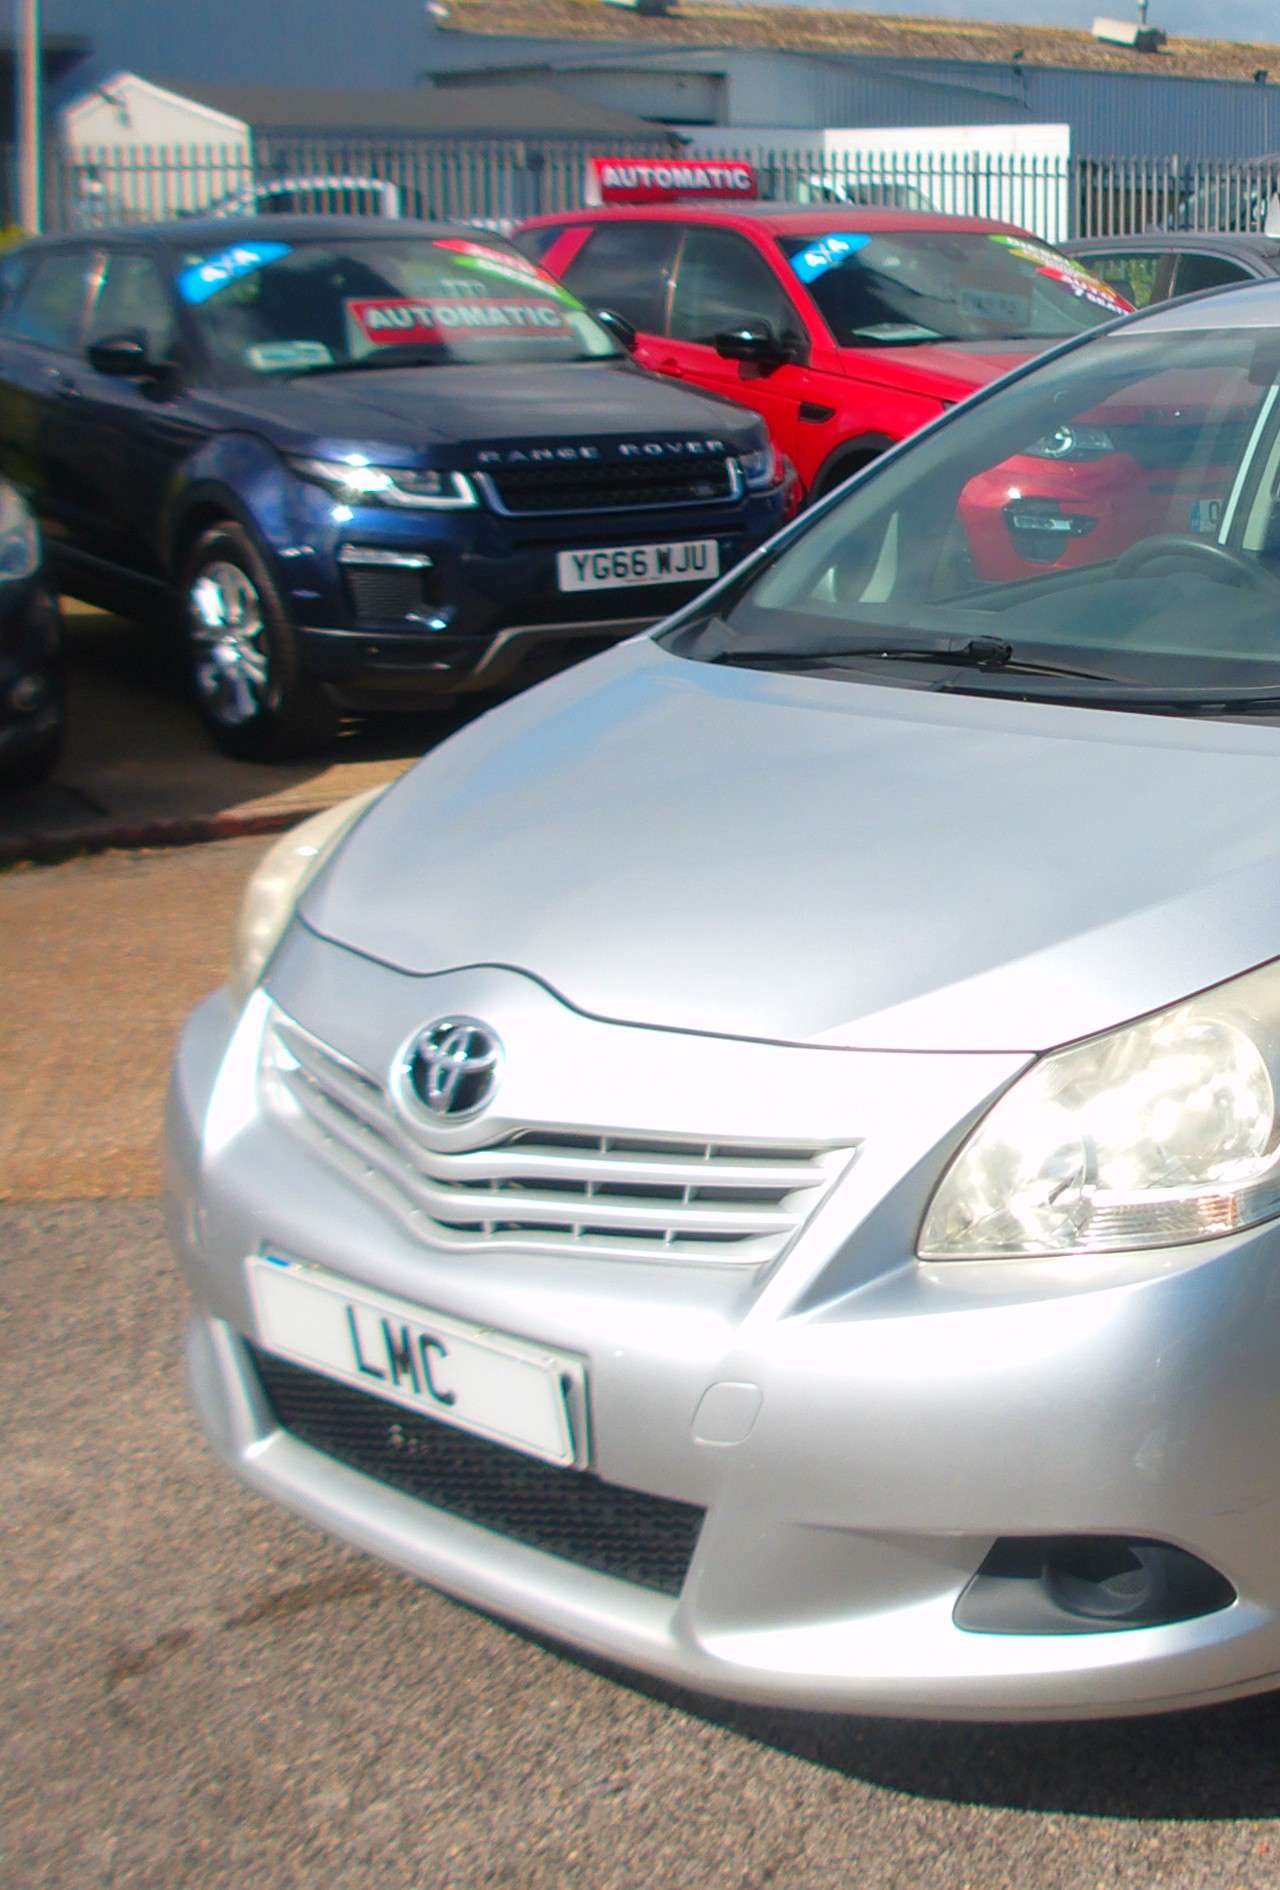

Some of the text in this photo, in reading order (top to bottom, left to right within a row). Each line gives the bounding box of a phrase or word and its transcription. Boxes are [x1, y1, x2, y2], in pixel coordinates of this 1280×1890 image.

[603, 164, 751, 189] AUTOMATIC
[365, 304, 563, 330] AUTOMATIC
[478, 440, 724, 463] RANGE ROVER
[571, 543, 708, 583] YG66 WJU
[346, 1304, 457, 1407] LMC
